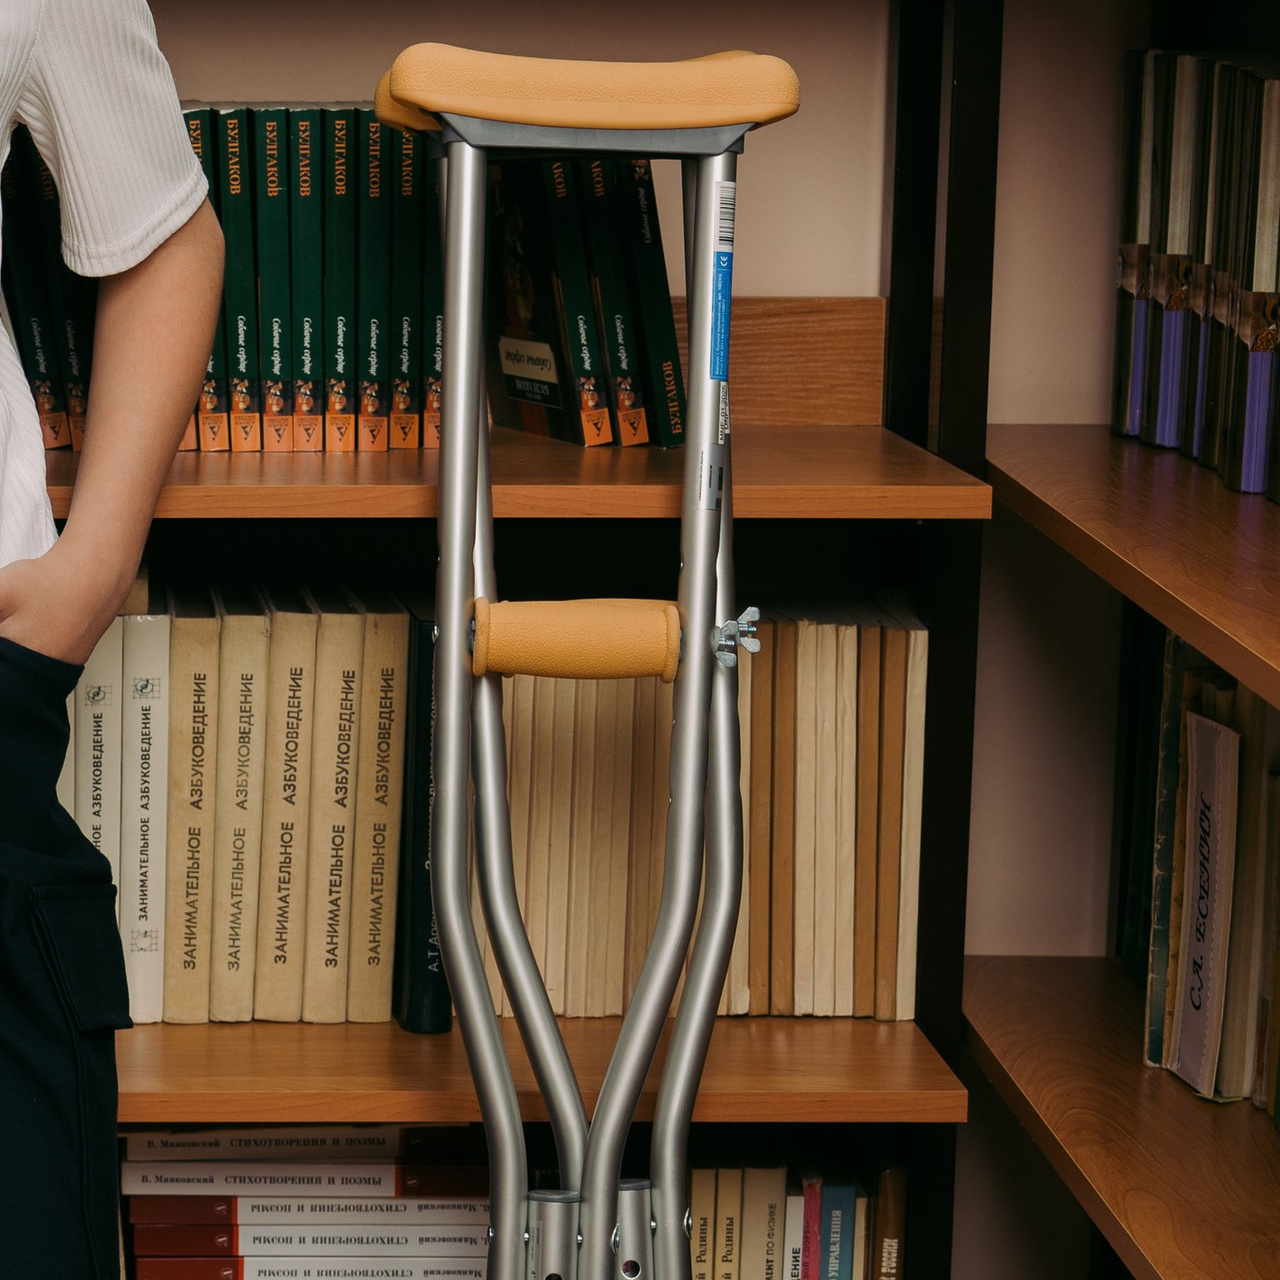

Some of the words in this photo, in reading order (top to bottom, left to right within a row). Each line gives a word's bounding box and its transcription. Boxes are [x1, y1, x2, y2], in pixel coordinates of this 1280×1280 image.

[227, 120, 242, 196] БУЛГАКОВ
[299, 122, 311, 197] БУЛГАКОВ
[335, 120, 347, 196] БУЛГАКОВ
[663, 361, 684, 435] БУЛГАКОВ
[140, 705, 153, 811] АЗБУКОВЕДЕНИЕ
[190, 673, 209, 811] АЗБУКОВЕДЕНИЕ
[334, 670, 356, 809] АЗБУКОВЕДЕНИЕ
[375, 668, 396, 807] АЗБУКОВЕДЕНИЕ
[139, 818, 151, 922] ЗАНИМАТЕЛЬНОЕ
[183, 827, 202, 971] ЗАНИМАТЕЛЬНОЕ
[325, 825, 346, 969] ЗАНИМАТЕЛЬНОЕ
[368, 823, 388, 967] ЗАНИМАТЕЛЬНОЕ
[1196, 791, 1212, 944] ЕСЕНИН
[141, 1176, 152, 1184] В.
[154, 1175, 215, 1185] Маяковский
[225, 1175, 322, 1186] СТИХОТВОРЕНИЯ
[328, 1177, 336, 1185] И
[341, 1176, 382, 1186] ПОЭМЫ
[251, 1205, 292, 1213] ПОЭМЫ
[298, 1205, 306, 1213] И
[311, 1204, 408, 1213] СТИХОТВОРЕНИЯ
[723, 1217, 734, 1264] Родины
[829, 1210, 842, 1279] УПРАВЛЕНИЯ
